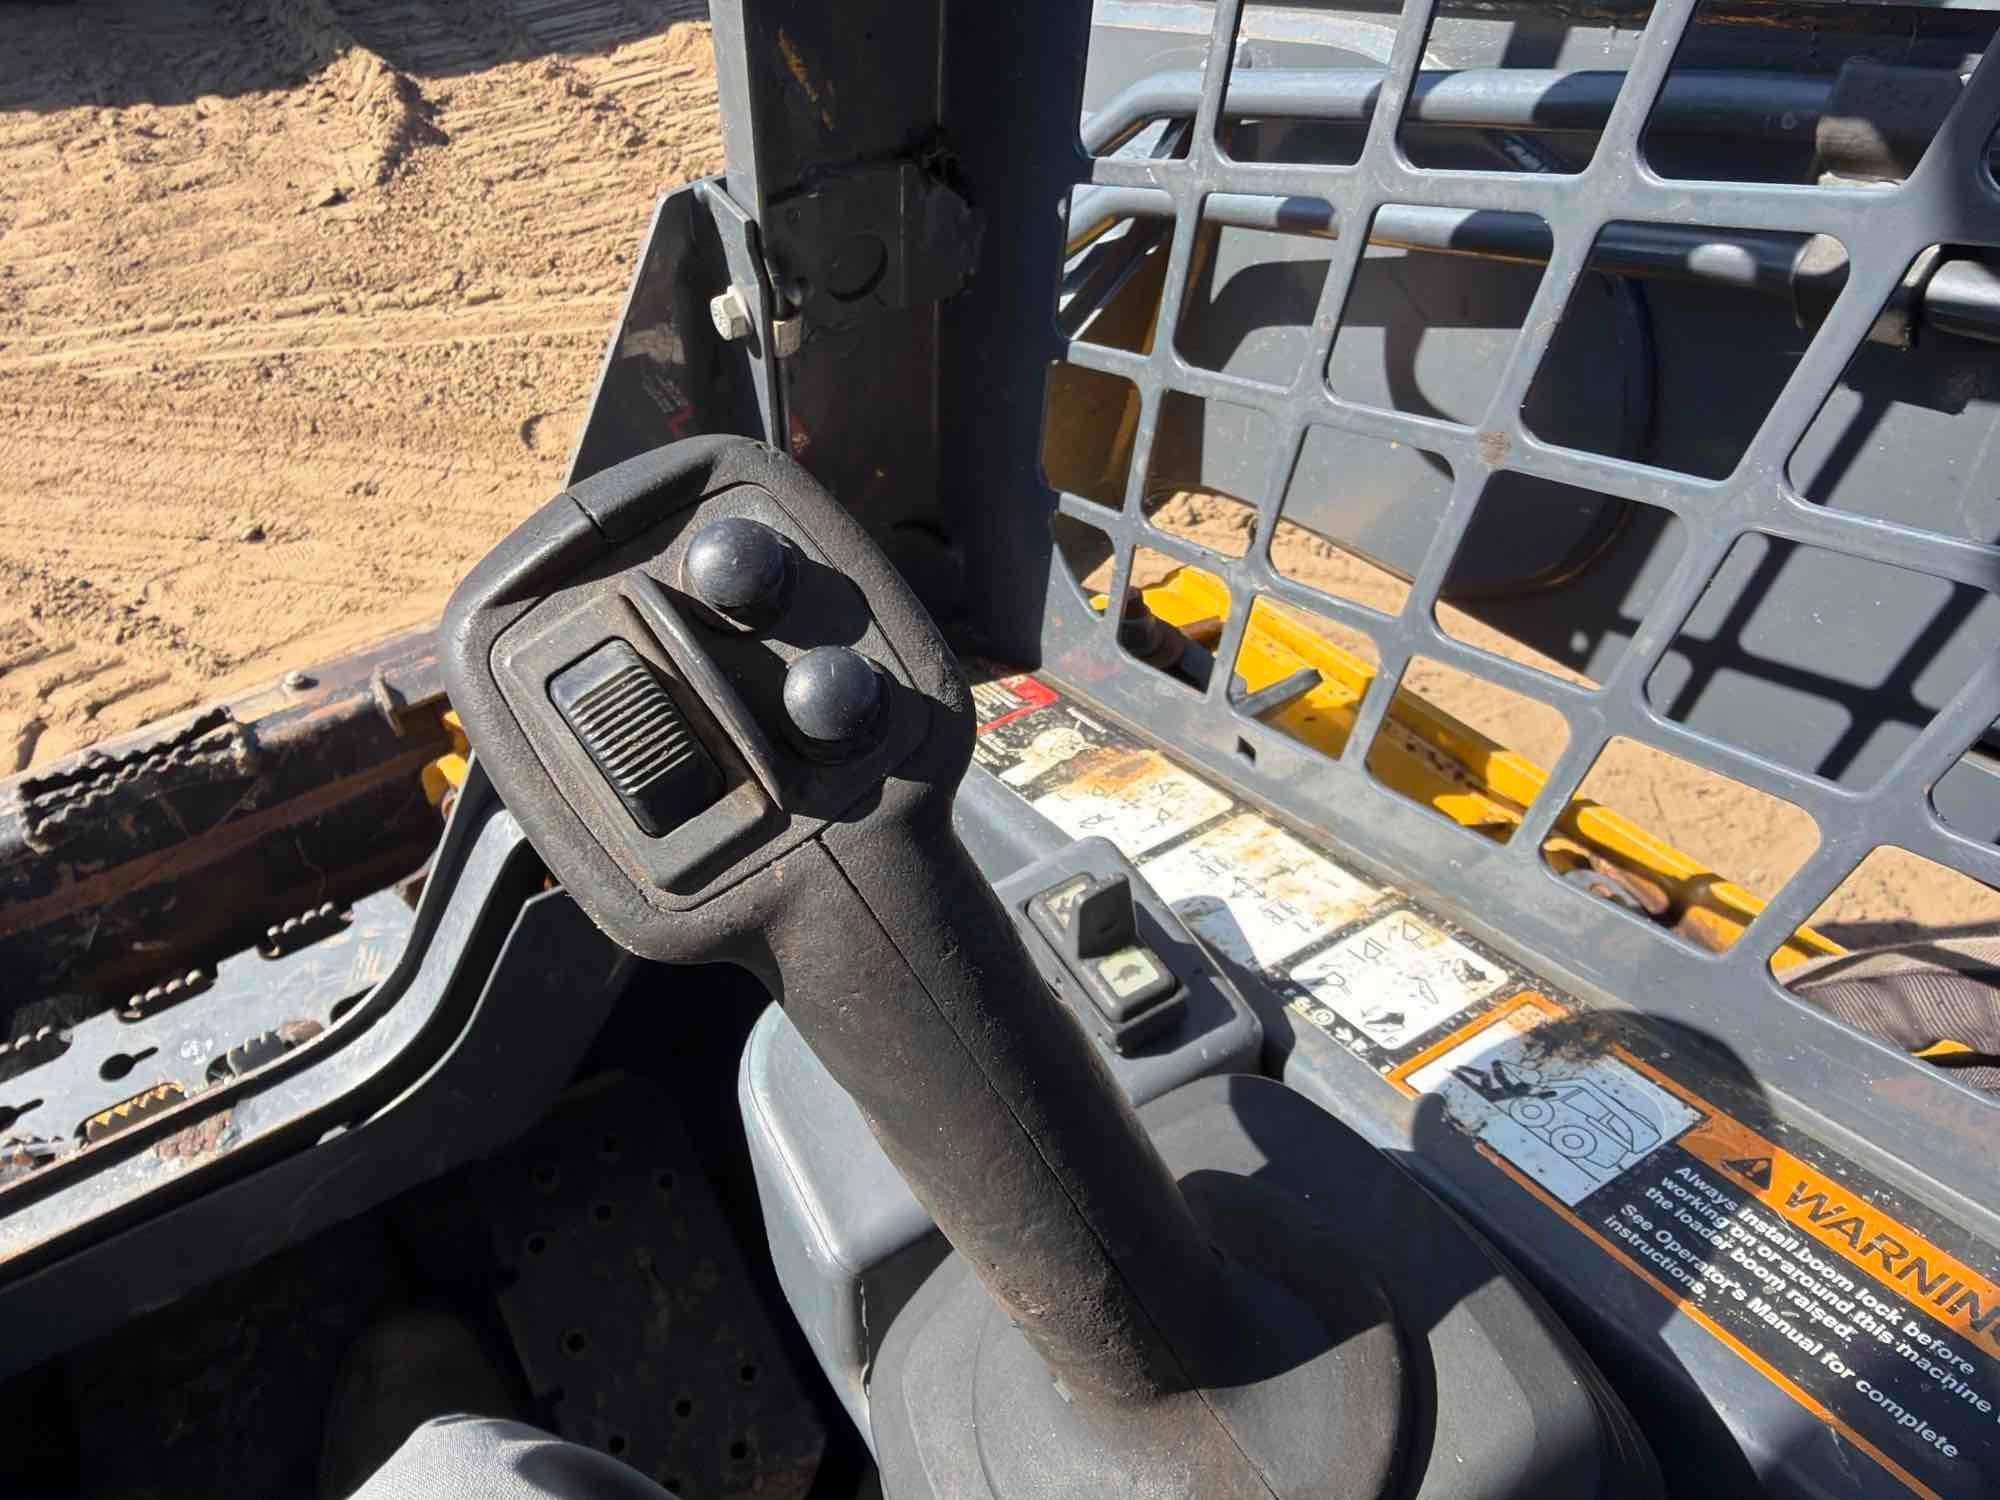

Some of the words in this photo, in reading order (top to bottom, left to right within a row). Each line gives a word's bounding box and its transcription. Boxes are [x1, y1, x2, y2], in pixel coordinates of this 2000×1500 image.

[1603, 1215, 1707, 1298] instructions.
[1620, 1204, 1653, 1231] See
[1655, 1230, 1748, 1301] Operator's
[1746, 1297, 1824, 1355] Manual
[1820, 1352, 1856, 1378] for
[1856, 1380, 1958, 1458] complete
[1645, 1187, 1673, 1210] the
[1674, 1208, 1733, 1250] loader
[1730, 1247, 1786, 1292] boom
[1661, 1177, 1730, 1229] working
[1729, 1226, 1756, 1247] on
[1757, 1245, 1783, 1262] or
[1780, 1259, 1856, 1314] around
[1853, 1310, 1895, 1344] this
[1896, 1341, 1992, 1413] machine
[1675, 1167, 1738, 1211] Always
[1737, 1208, 1800, 1251] install
[1795, 1247, 1855, 1292] boom
[1855, 1288, 1903, 1325] lock
[1902, 1321, 1976, 1374] before
